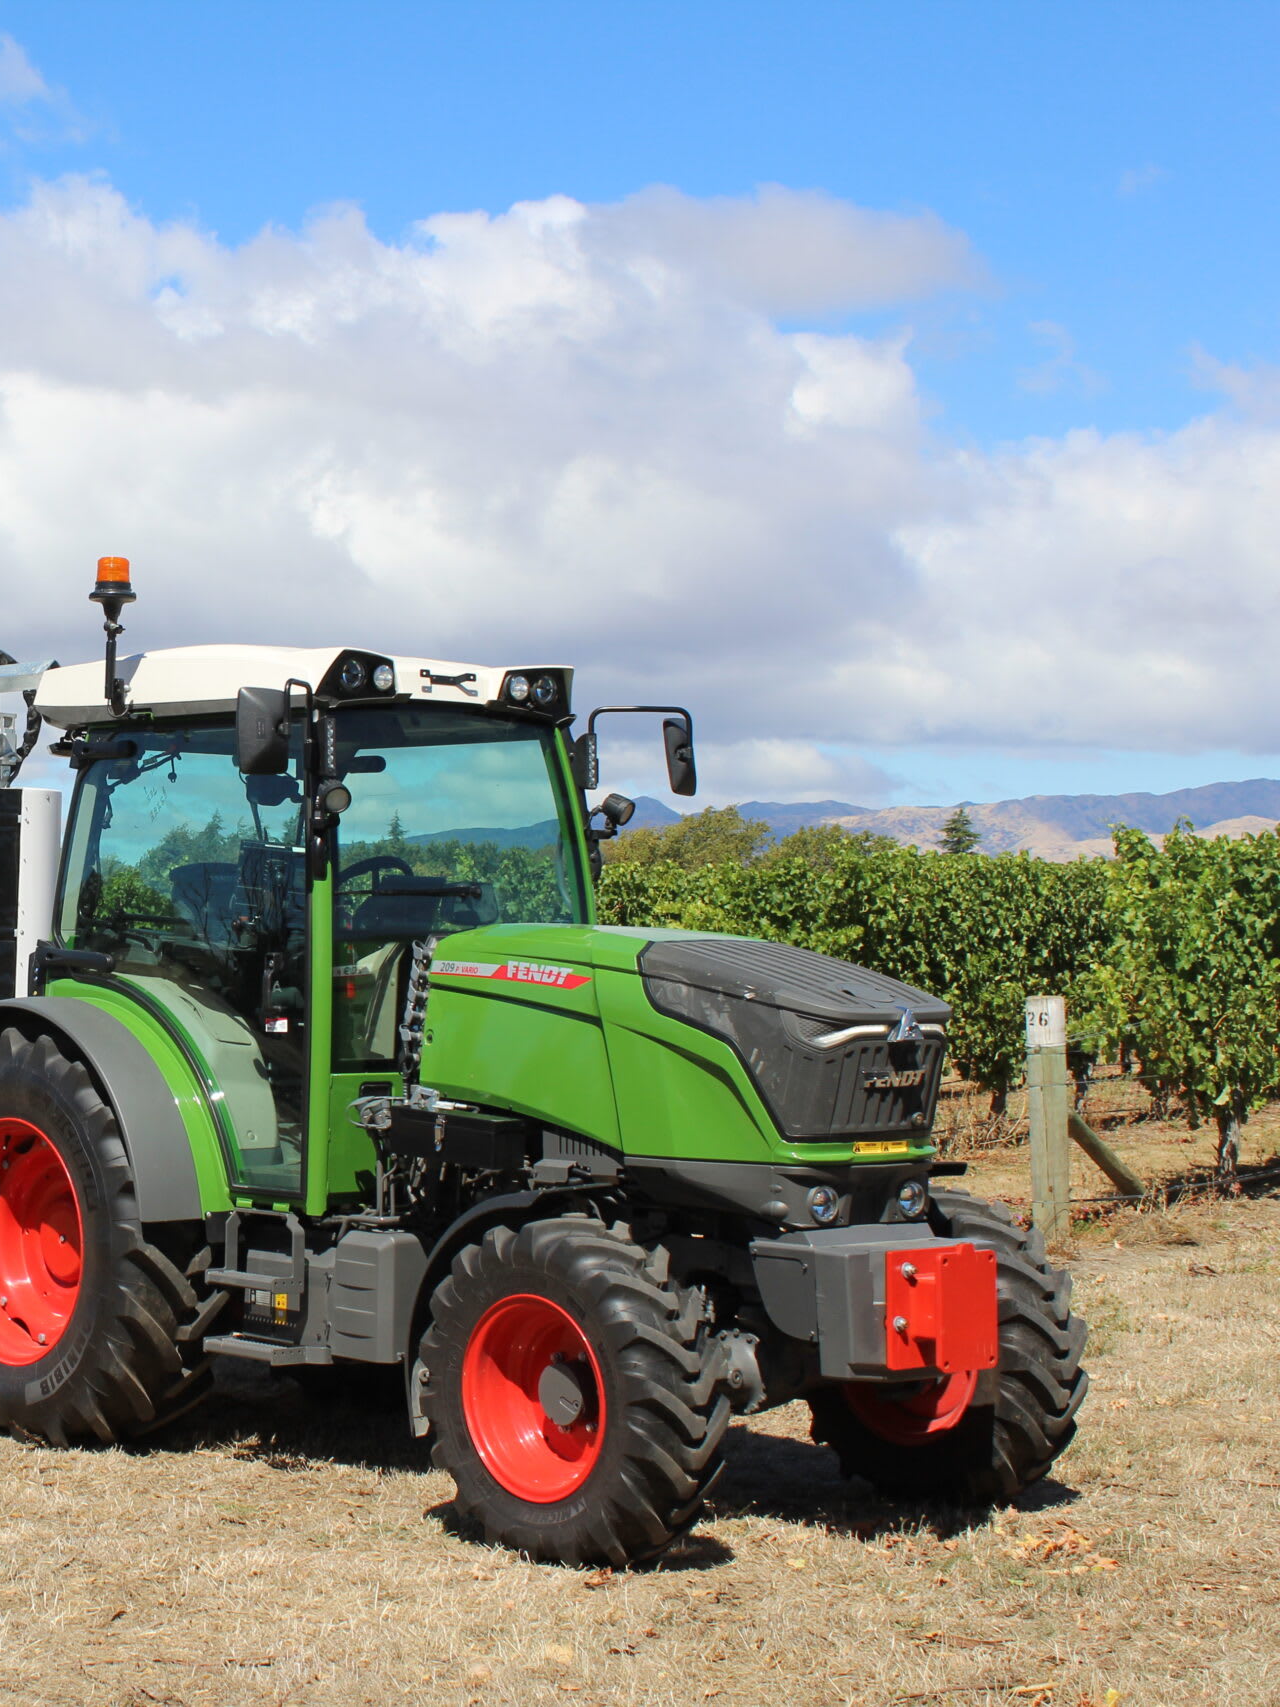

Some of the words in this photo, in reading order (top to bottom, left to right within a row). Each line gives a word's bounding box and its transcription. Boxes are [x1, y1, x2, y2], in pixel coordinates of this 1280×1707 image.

[440, 962, 455, 973] 209
[461, 966, 479, 974] VARIO
[507, 960, 574, 985] FENDT
[1027, 1011, 1049, 1027] 26
[863, 1070, 927, 1089] FENDT
